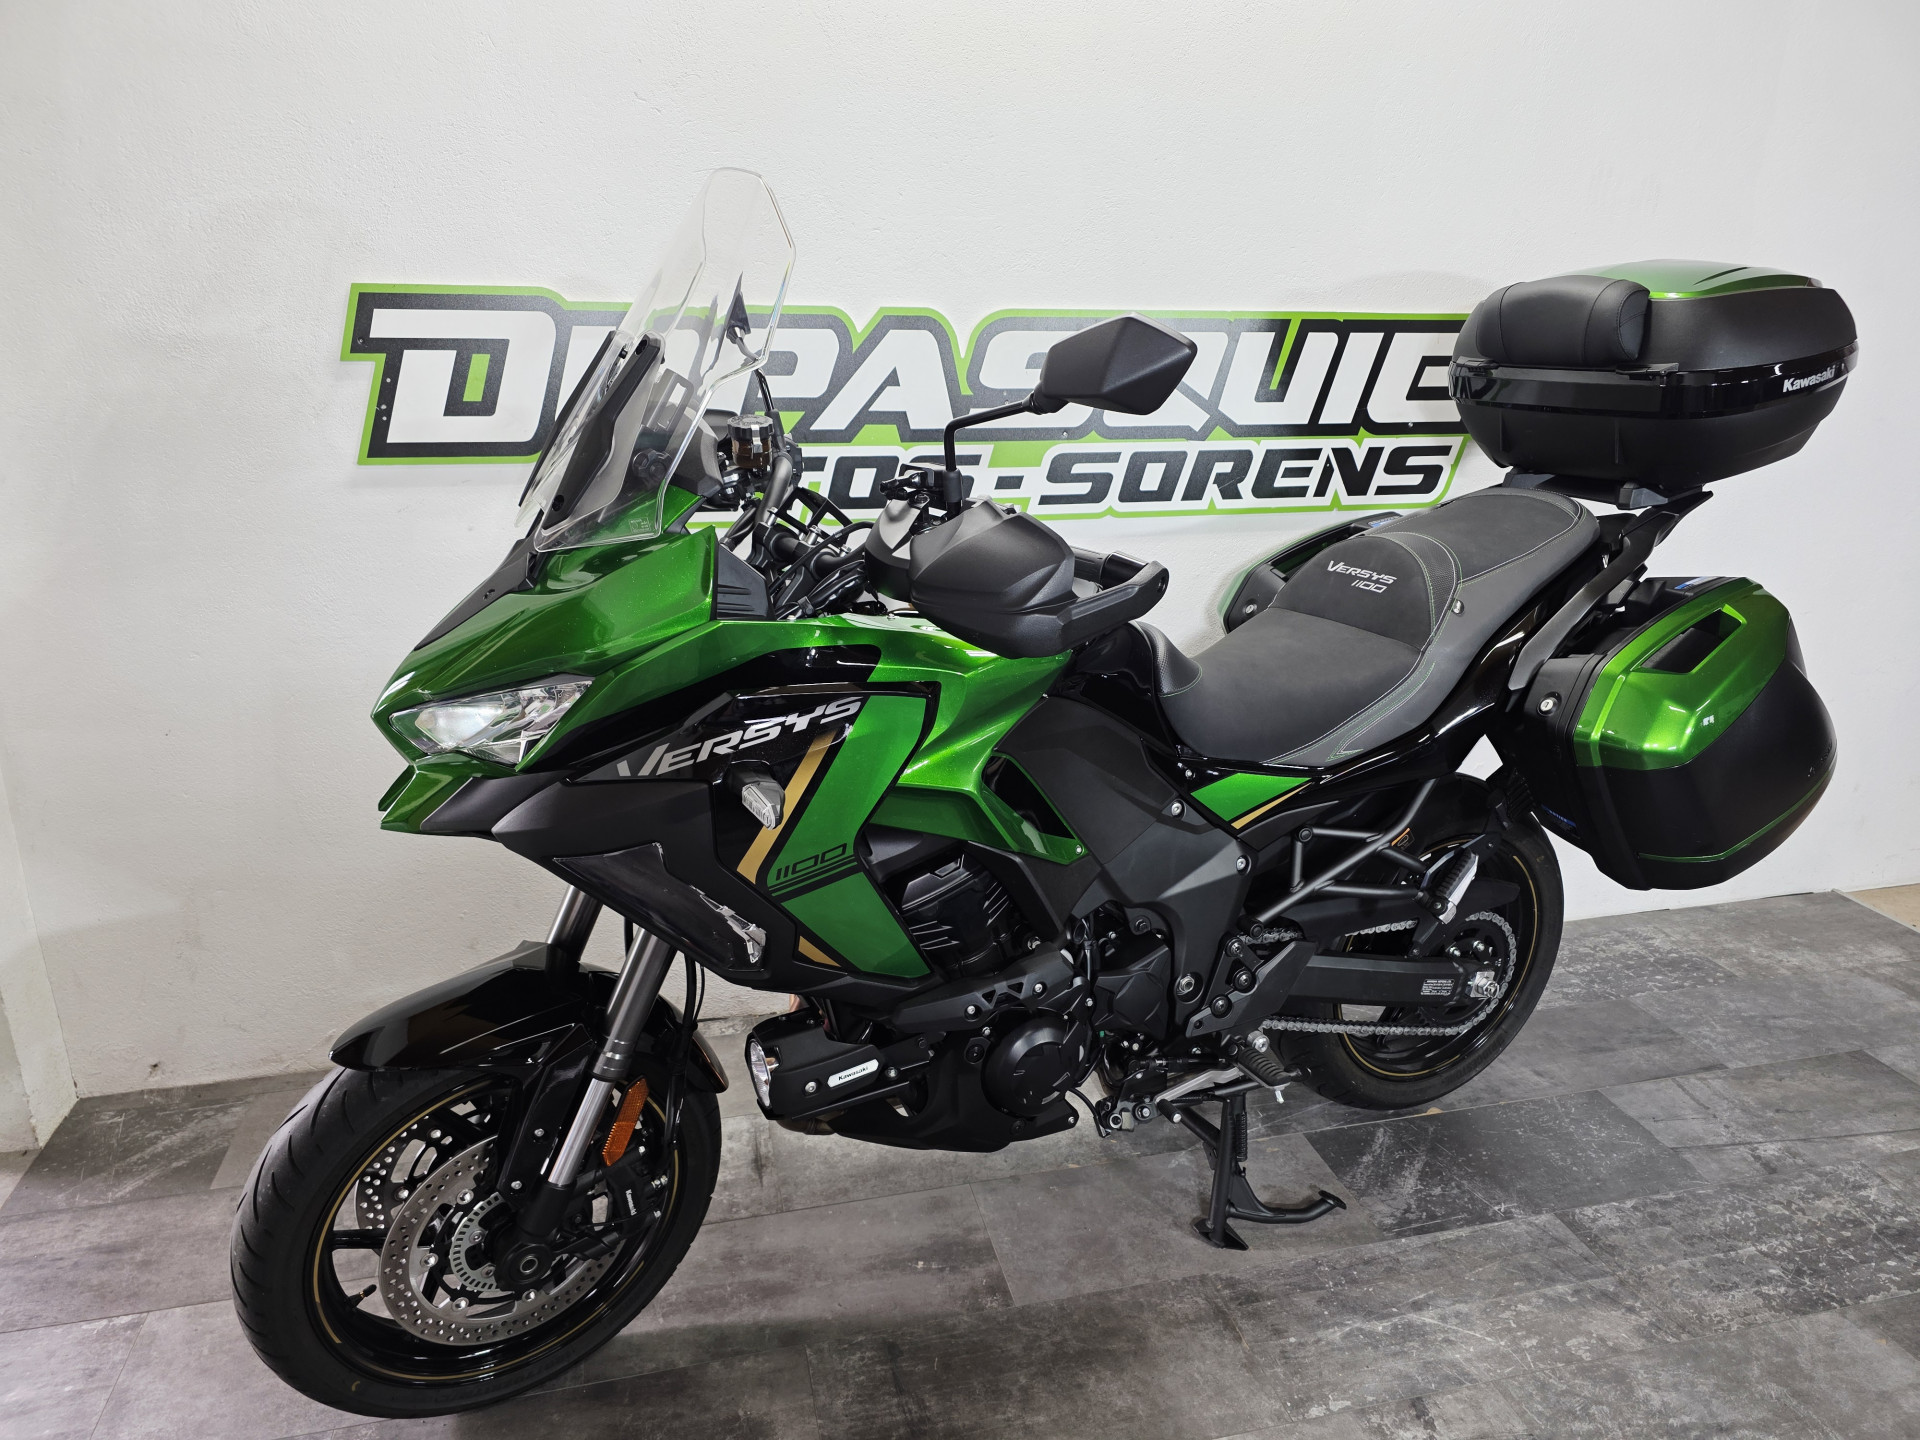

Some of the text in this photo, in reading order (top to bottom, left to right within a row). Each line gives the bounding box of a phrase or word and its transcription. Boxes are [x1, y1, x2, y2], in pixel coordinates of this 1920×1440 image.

[1782, 364, 1836, 393] Kawasaki
[1038, 445, 1452, 506] SORENS
[1326, 560, 1398, 585] VERSYS
[1351, 579, 1388, 594] 1100
[617, 696, 864, 777] VERSYS
[775, 843, 848, 881] 1100
